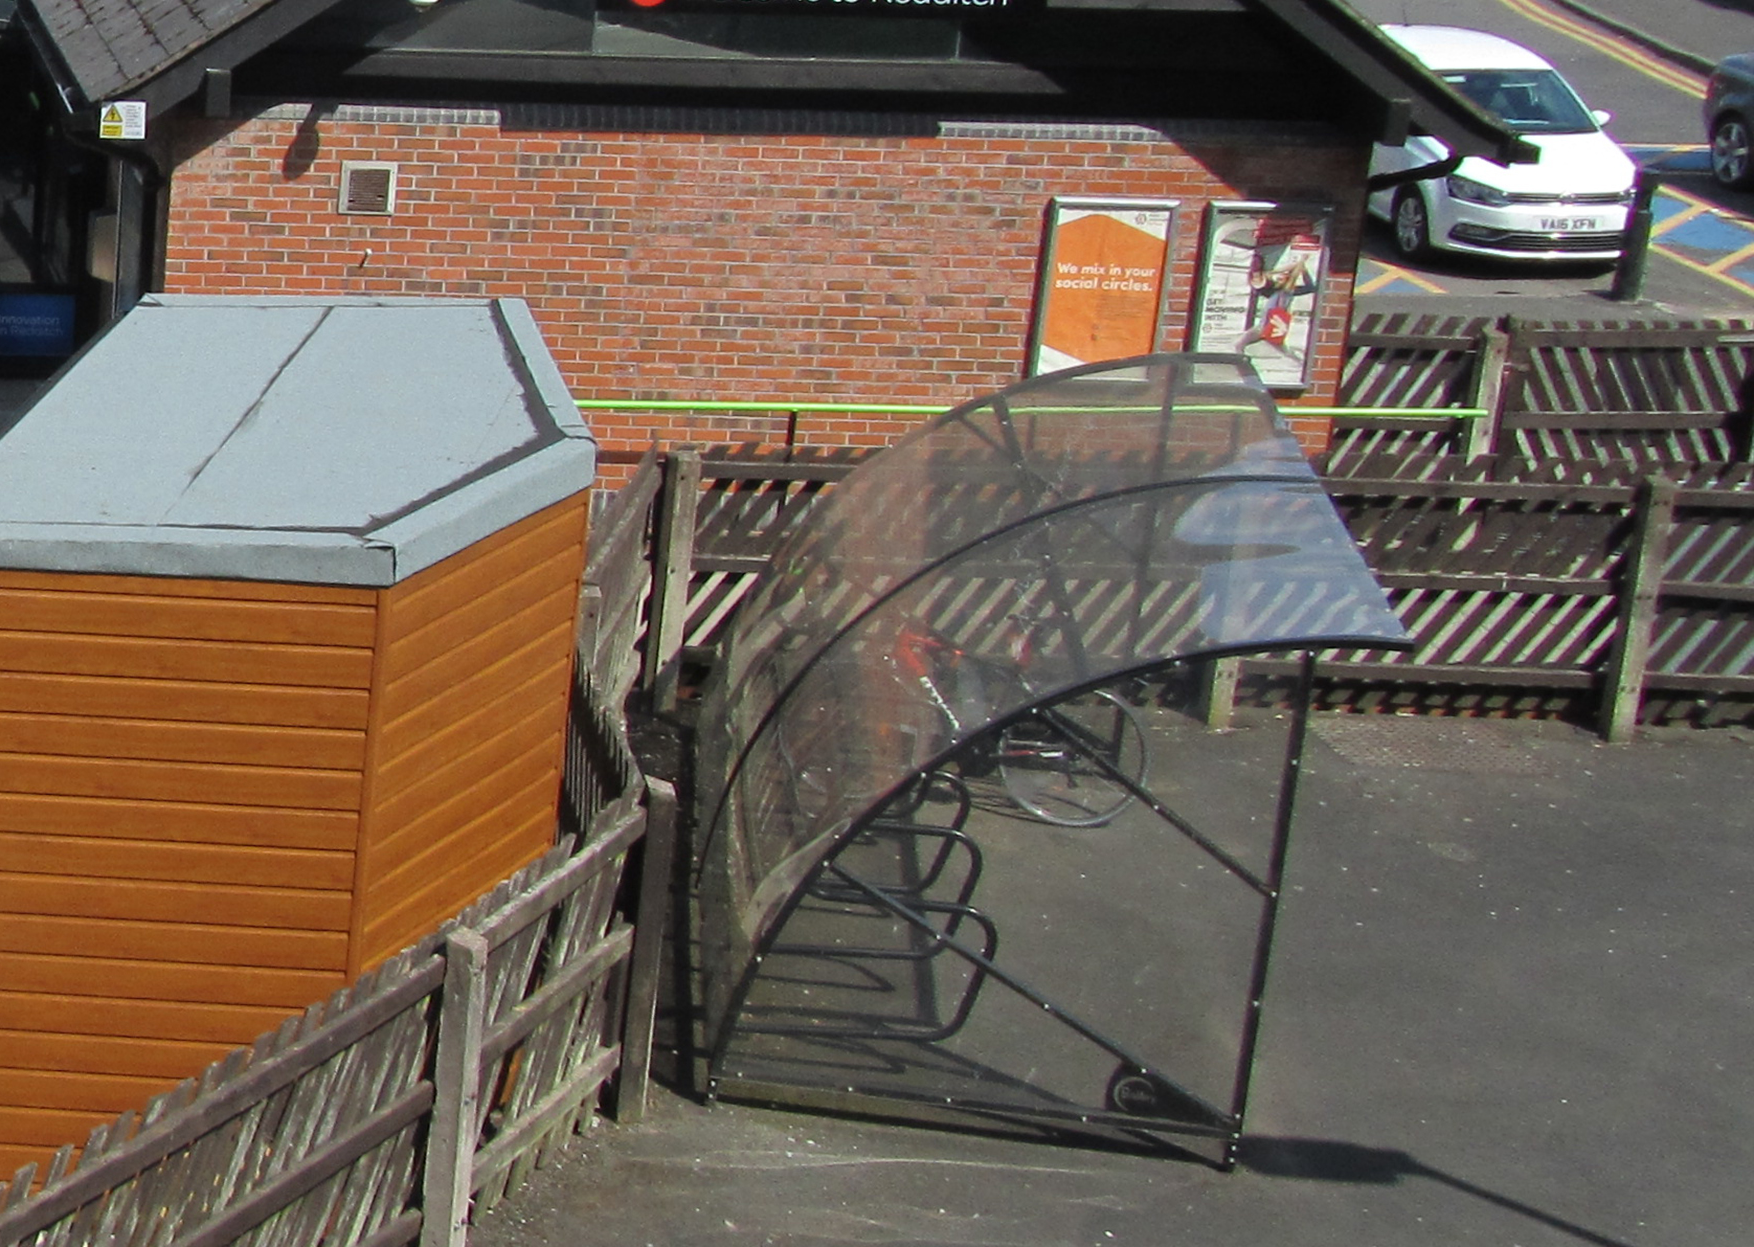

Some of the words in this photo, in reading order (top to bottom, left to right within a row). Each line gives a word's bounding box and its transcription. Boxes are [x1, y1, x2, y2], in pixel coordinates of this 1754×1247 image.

[1056, 262, 1078, 274] We
[1080, 263, 1106, 275] mix
[1109, 263, 1122, 276] in
[1124, 267, 1156, 278] your
[1055, 276, 1099, 289] social
[1101, 277, 1153, 292] circles.
